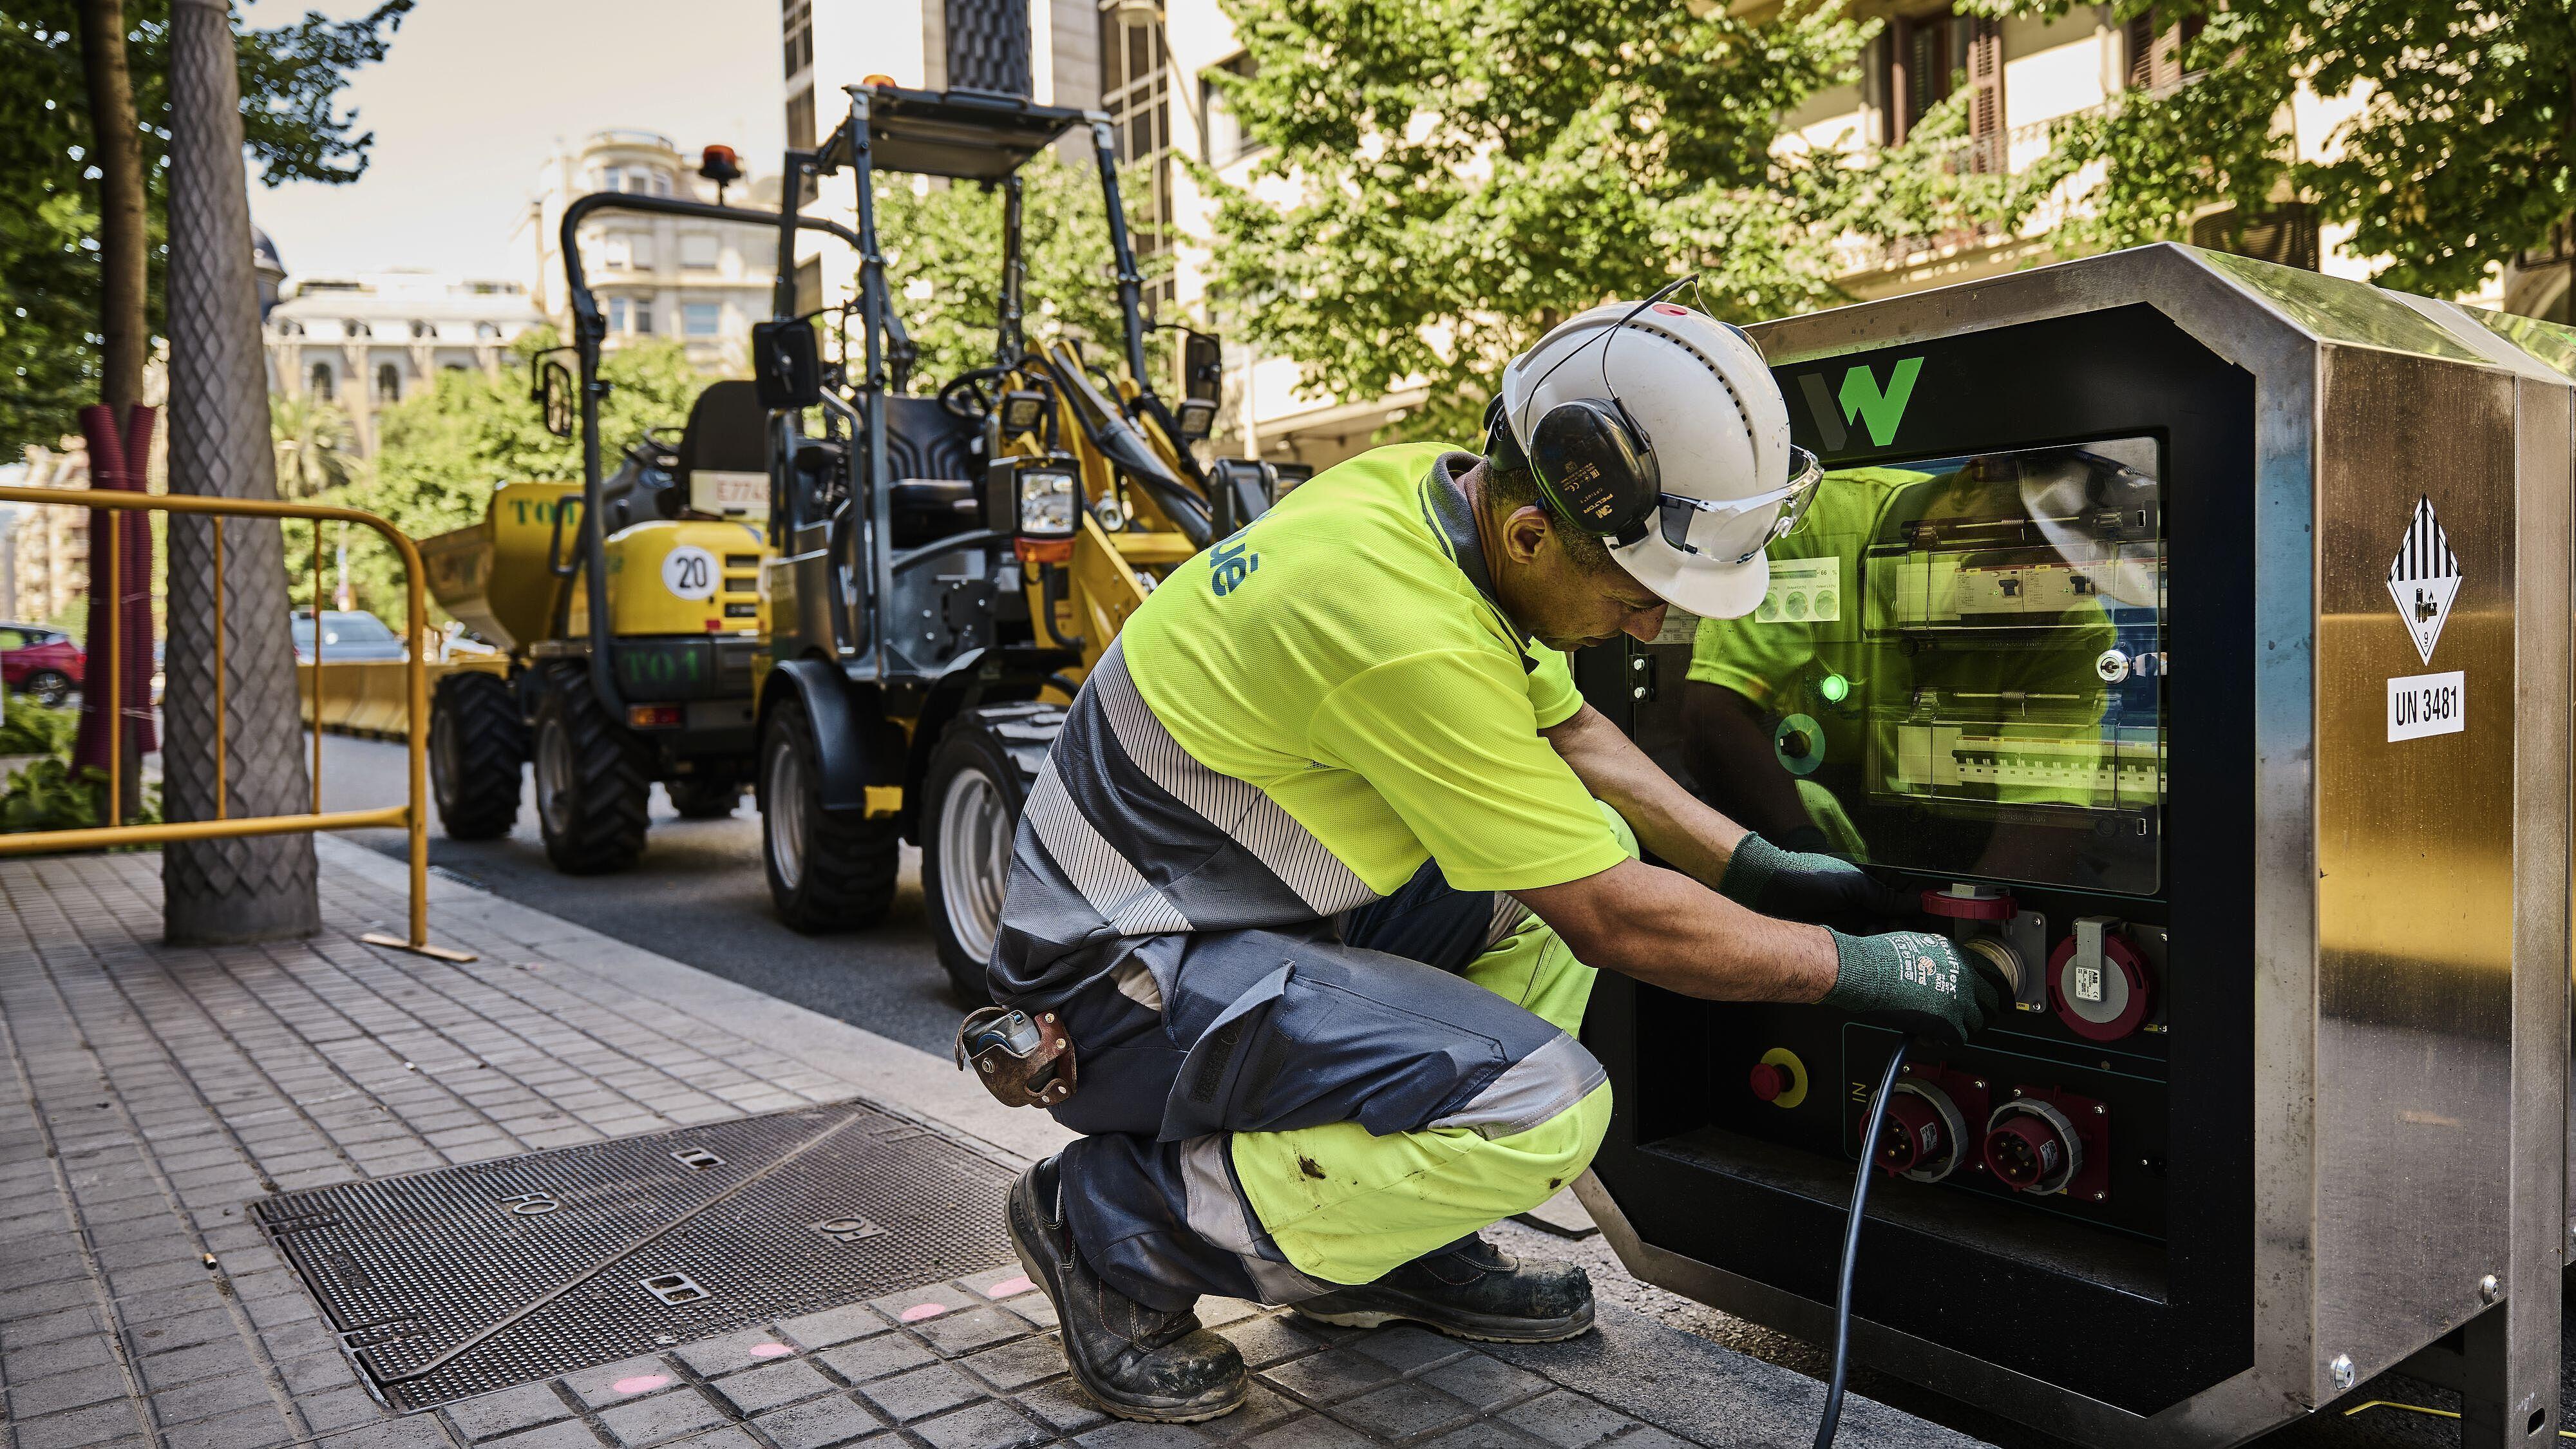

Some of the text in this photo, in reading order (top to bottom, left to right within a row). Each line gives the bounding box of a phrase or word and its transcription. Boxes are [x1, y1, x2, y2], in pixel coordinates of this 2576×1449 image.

[1583, 493, 1614, 513] PELTOR
[1596, 505, 1613, 518] 3M
[675, 557, 708, 589] 20
[2424, 632, 2429, 645] 9
[2396, 685, 2456, 726] UN 3481
[1852, 1083, 1866, 1103] IN
[502, 1191, 559, 1215] FO
